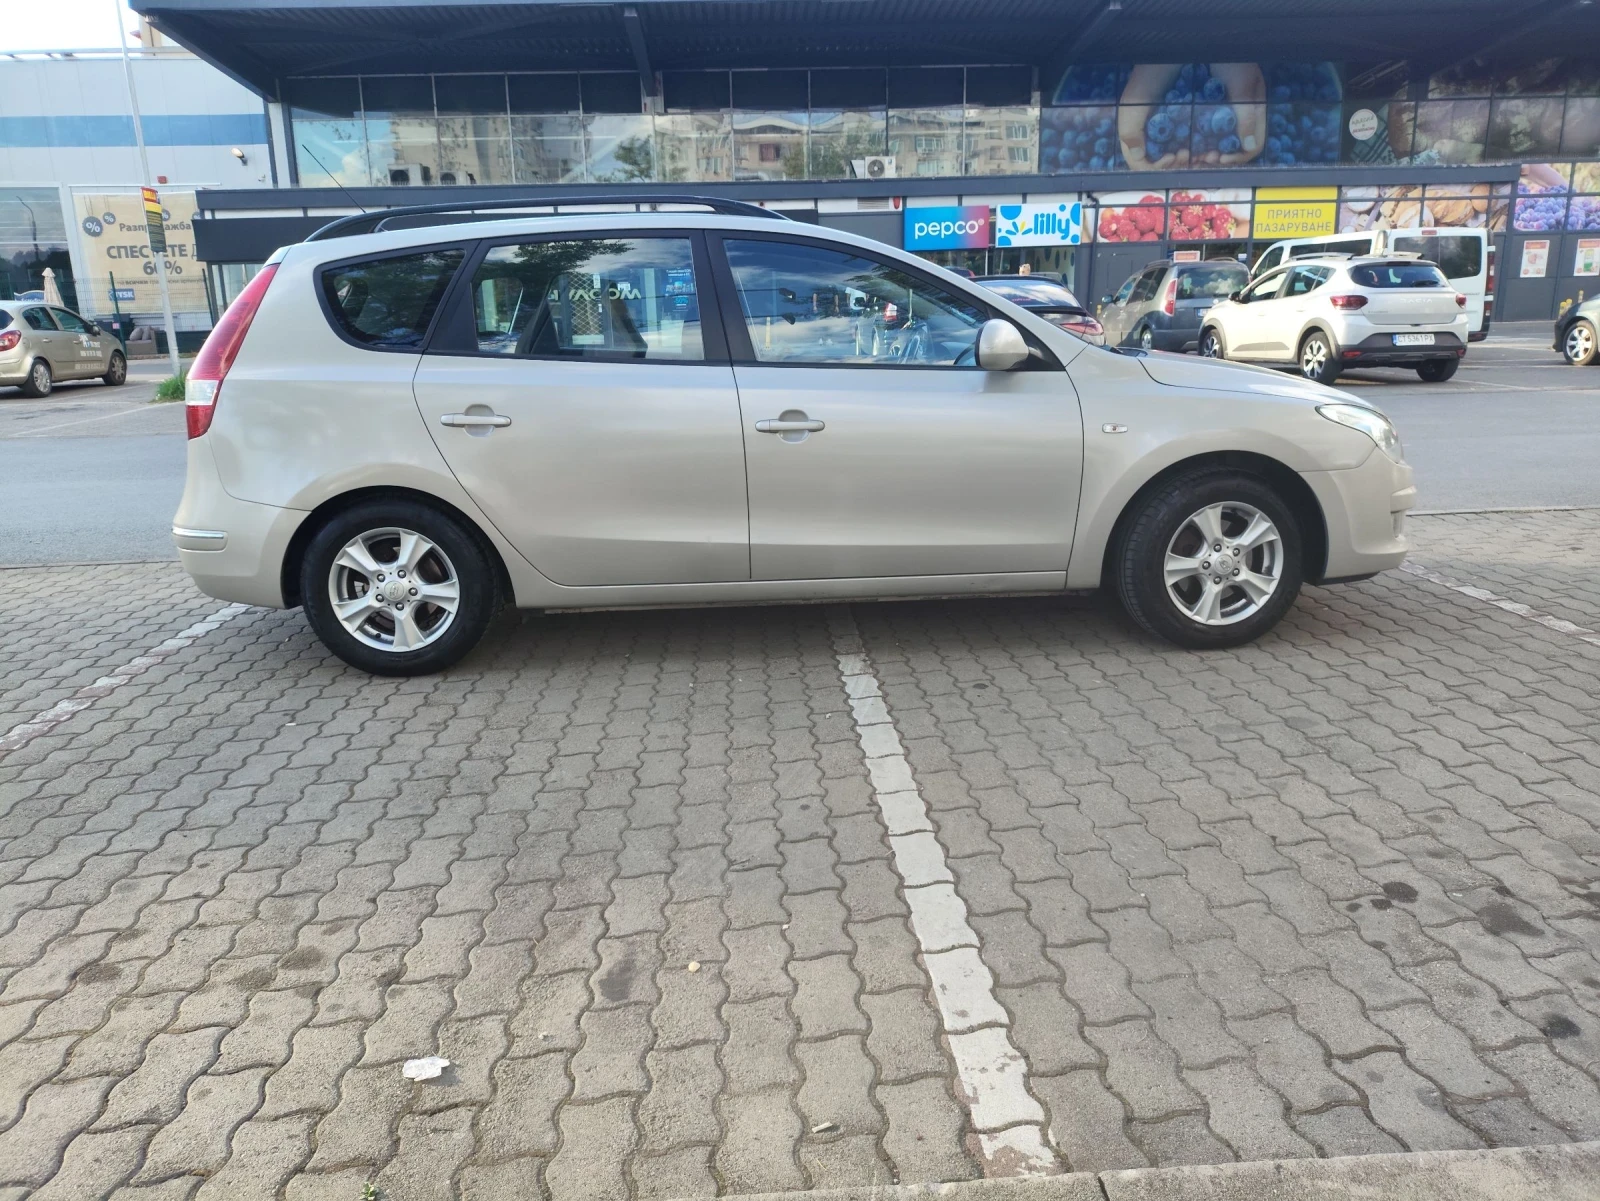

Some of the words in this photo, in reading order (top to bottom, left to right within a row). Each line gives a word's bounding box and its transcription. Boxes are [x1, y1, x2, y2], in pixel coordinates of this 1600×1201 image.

[1267, 208, 1322, 219] ПРИЯТНО
[85, 221, 101, 233] %
[914, 220, 979, 239] pepco
[1033, 213, 1071, 240] lilly
[1255, 221, 1333, 232] ПАЗАРУВАНЕ
